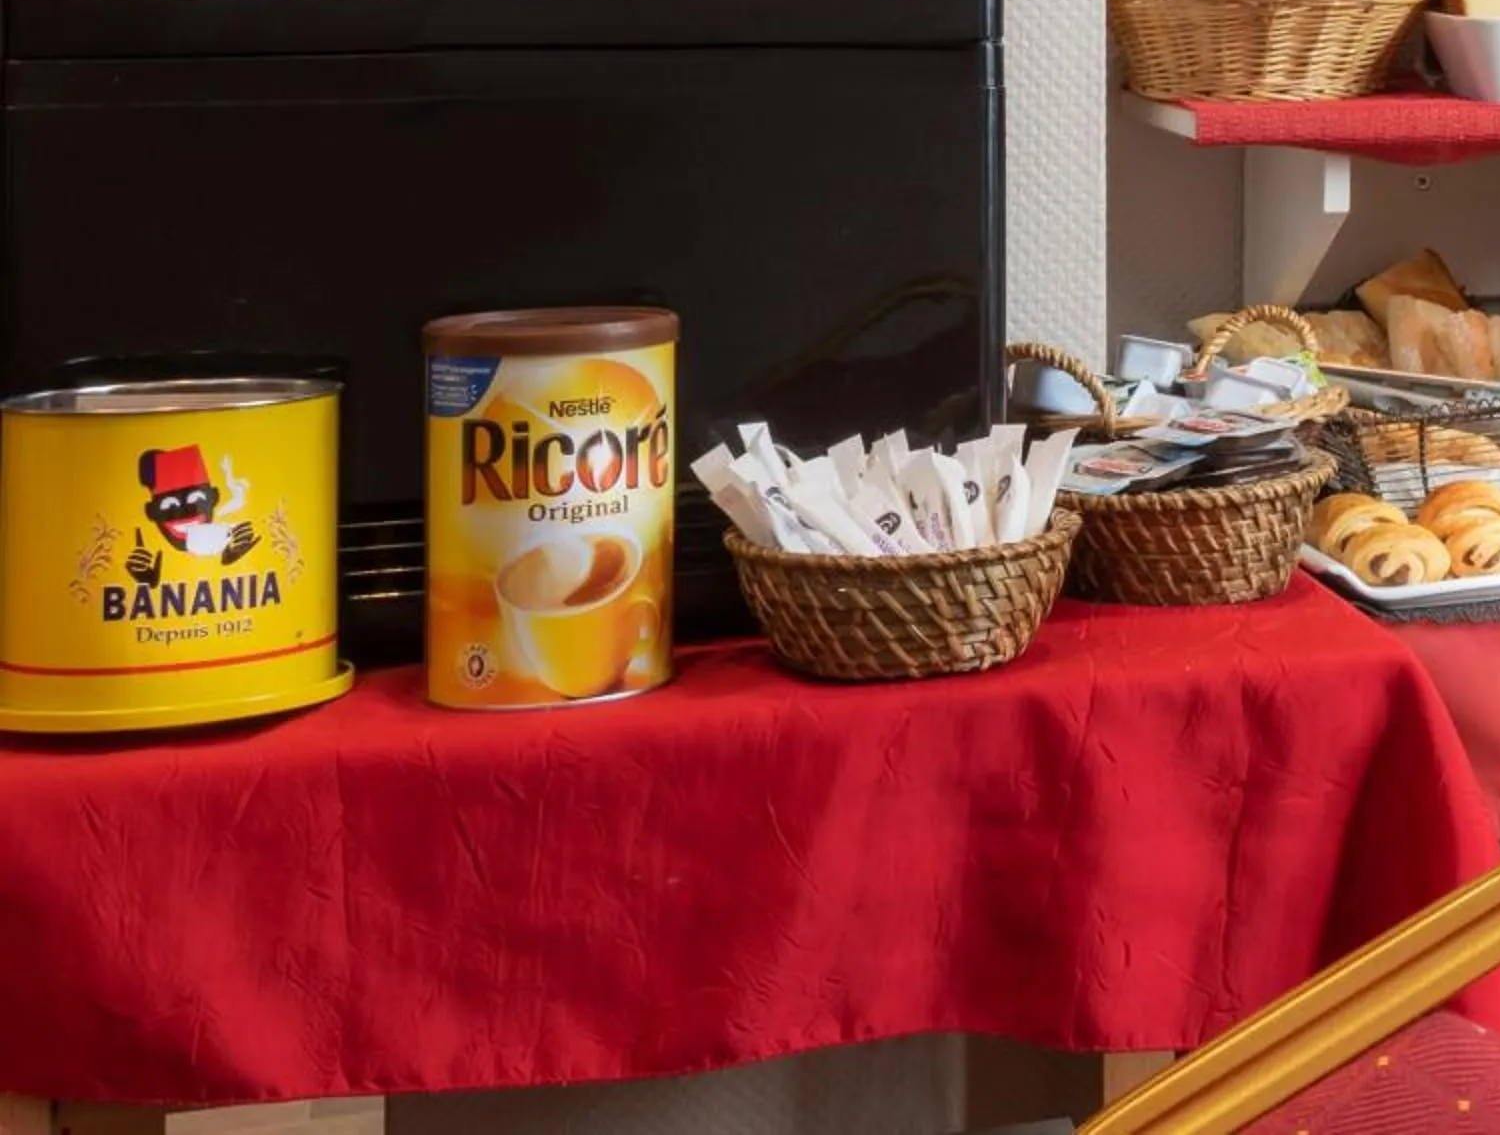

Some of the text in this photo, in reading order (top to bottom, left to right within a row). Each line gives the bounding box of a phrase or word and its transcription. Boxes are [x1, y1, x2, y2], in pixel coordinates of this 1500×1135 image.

[462, 405, 668, 505] Ricoré
[527, 495, 629, 524] Original
[103, 570, 281, 622] BANANIA
[136, 618, 253, 646] Depuis 1912
